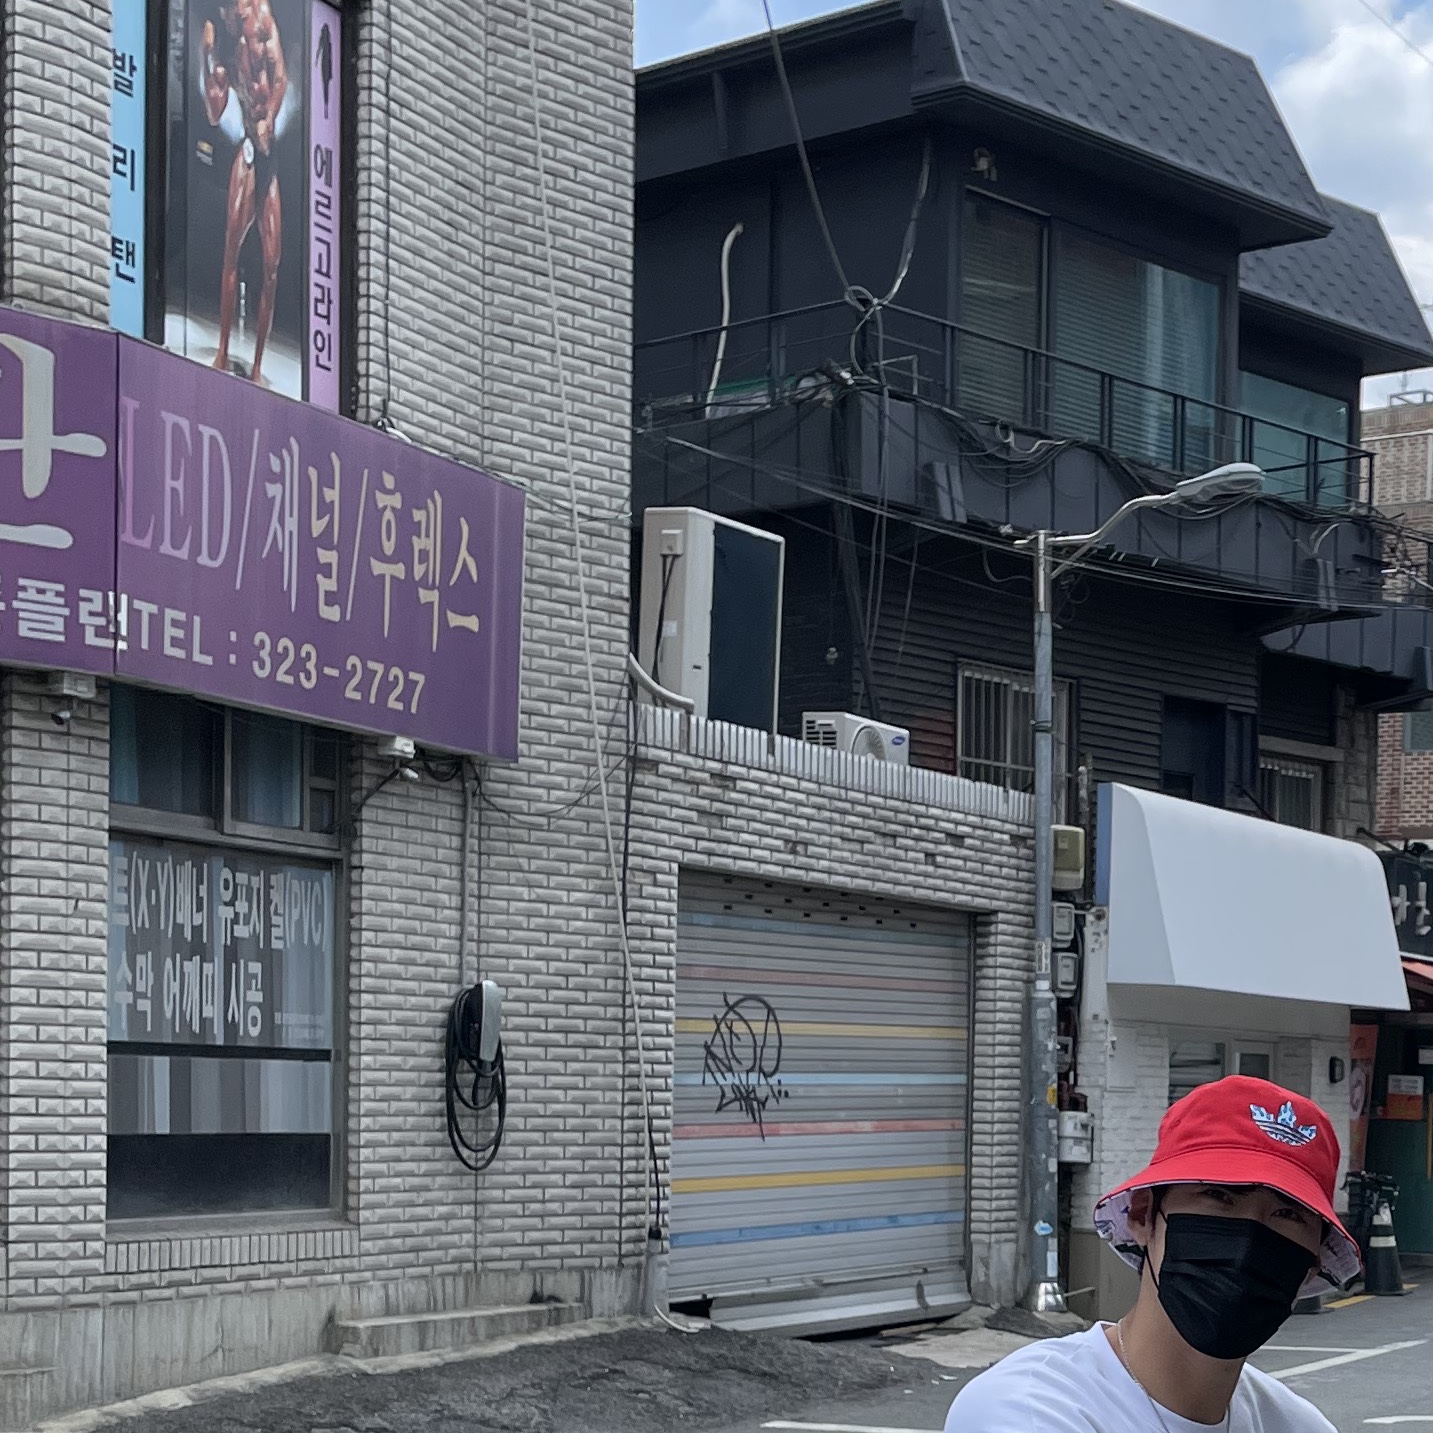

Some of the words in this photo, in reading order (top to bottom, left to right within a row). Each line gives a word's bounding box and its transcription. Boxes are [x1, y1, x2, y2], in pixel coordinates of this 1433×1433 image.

[0, 573, 128, 653] 플랜
[252, 631, 426, 714] 323-2727
[227, 958, 263, 1038] 시공
